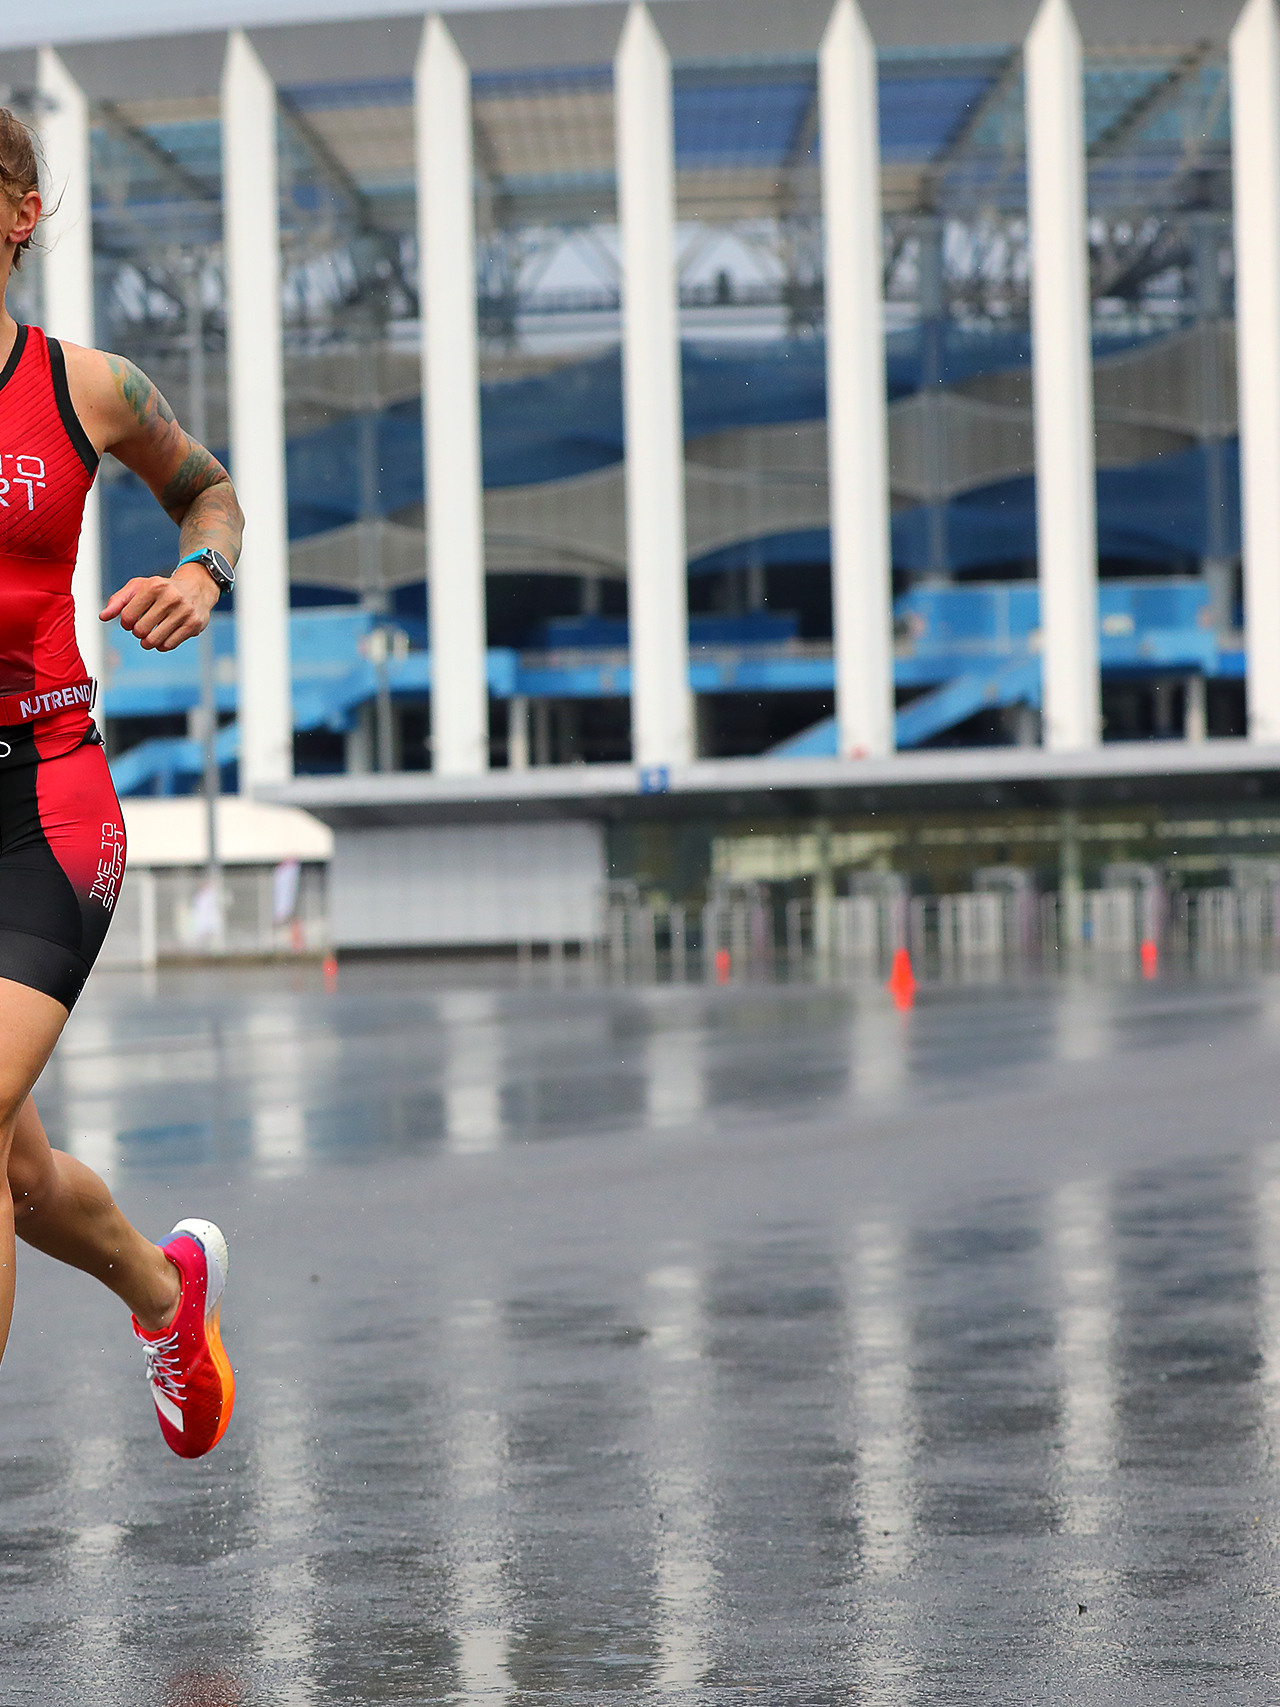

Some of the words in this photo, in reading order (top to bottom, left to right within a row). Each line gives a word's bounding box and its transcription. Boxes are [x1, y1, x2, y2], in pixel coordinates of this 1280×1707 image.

[89, 858, 112, 900] TIME
[101, 822, 114, 850] TO
[103, 823, 124, 912] SPORT
